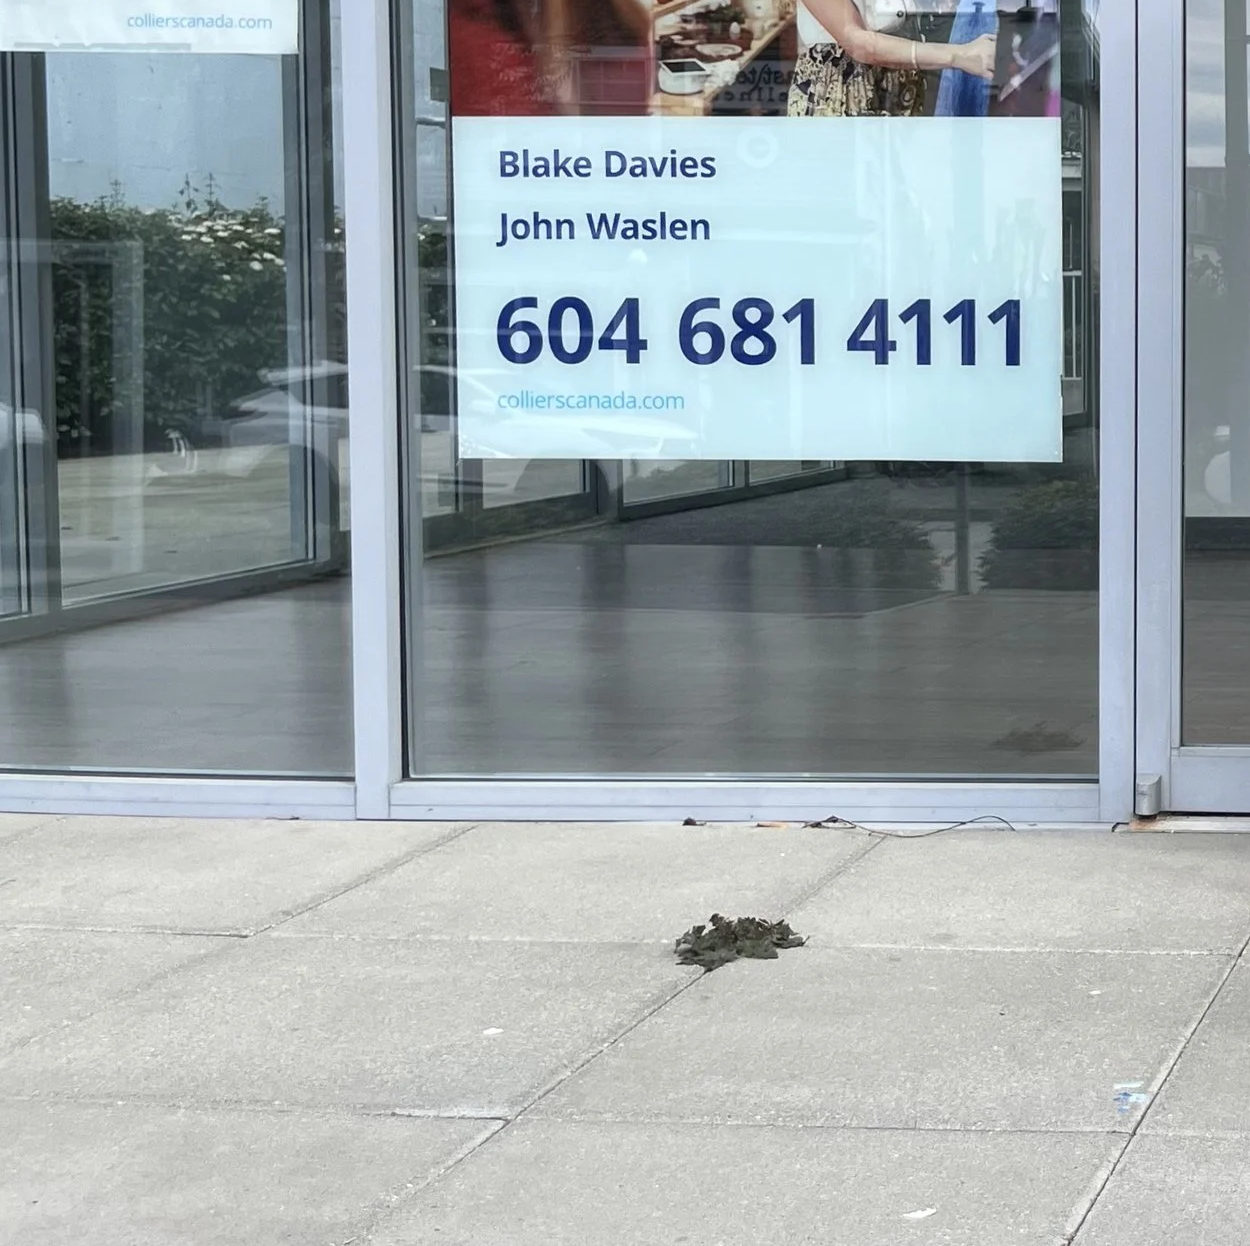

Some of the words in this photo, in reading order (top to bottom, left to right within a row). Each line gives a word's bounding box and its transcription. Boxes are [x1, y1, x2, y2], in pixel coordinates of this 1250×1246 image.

[127, 14, 273, 30] collierscanada.com
[499, 149, 593, 178] Blake
[604, 149, 717, 178] Davies
[496, 211, 576, 247] John
[586, 211, 711, 241] Waslen
[496, 296, 648, 366] 604
[678, 297, 816, 366] 681
[846, 297, 1021, 367] 4111
[497, 390, 686, 411] collierscanada.com
